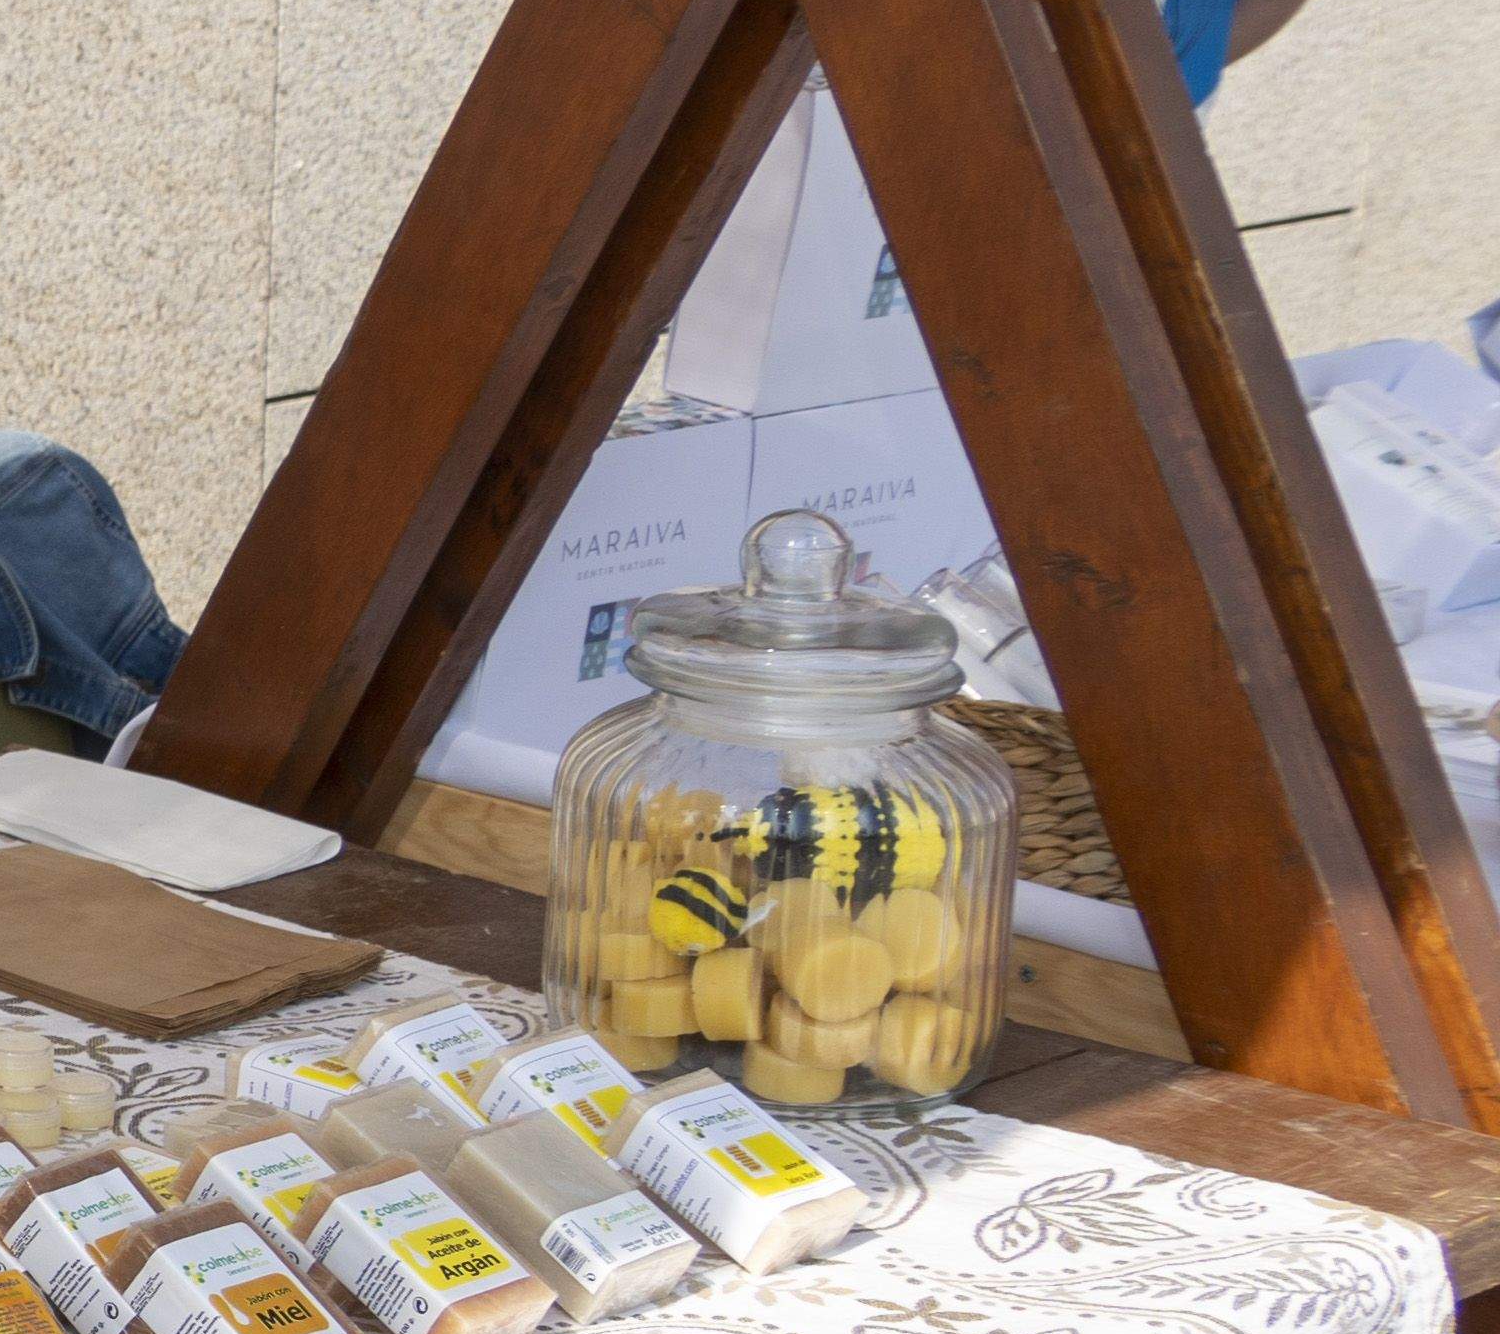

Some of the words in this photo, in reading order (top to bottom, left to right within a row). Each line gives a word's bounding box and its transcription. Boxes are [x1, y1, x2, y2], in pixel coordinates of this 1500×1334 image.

[802, 476, 916, 512] MARAIVA
[561, 518, 687, 562] MARAIVA
[70, 1188, 133, 1222] colmealoe
[375, 1189, 440, 1217] colmealoe
[427, 1231, 454, 1246] Jabón
[455, 1227, 471, 1237] con
[428, 1243, 467, 1261] Aceite
[467, 1236, 482, 1248] de
[197, 1241, 263, 1274] colmealoe
[439, 1252, 501, 1281] Argán
[247, 1292, 274, 1307] Jabón
[277, 1286, 292, 1297] con
[256, 1300, 312, 1330] Miel
